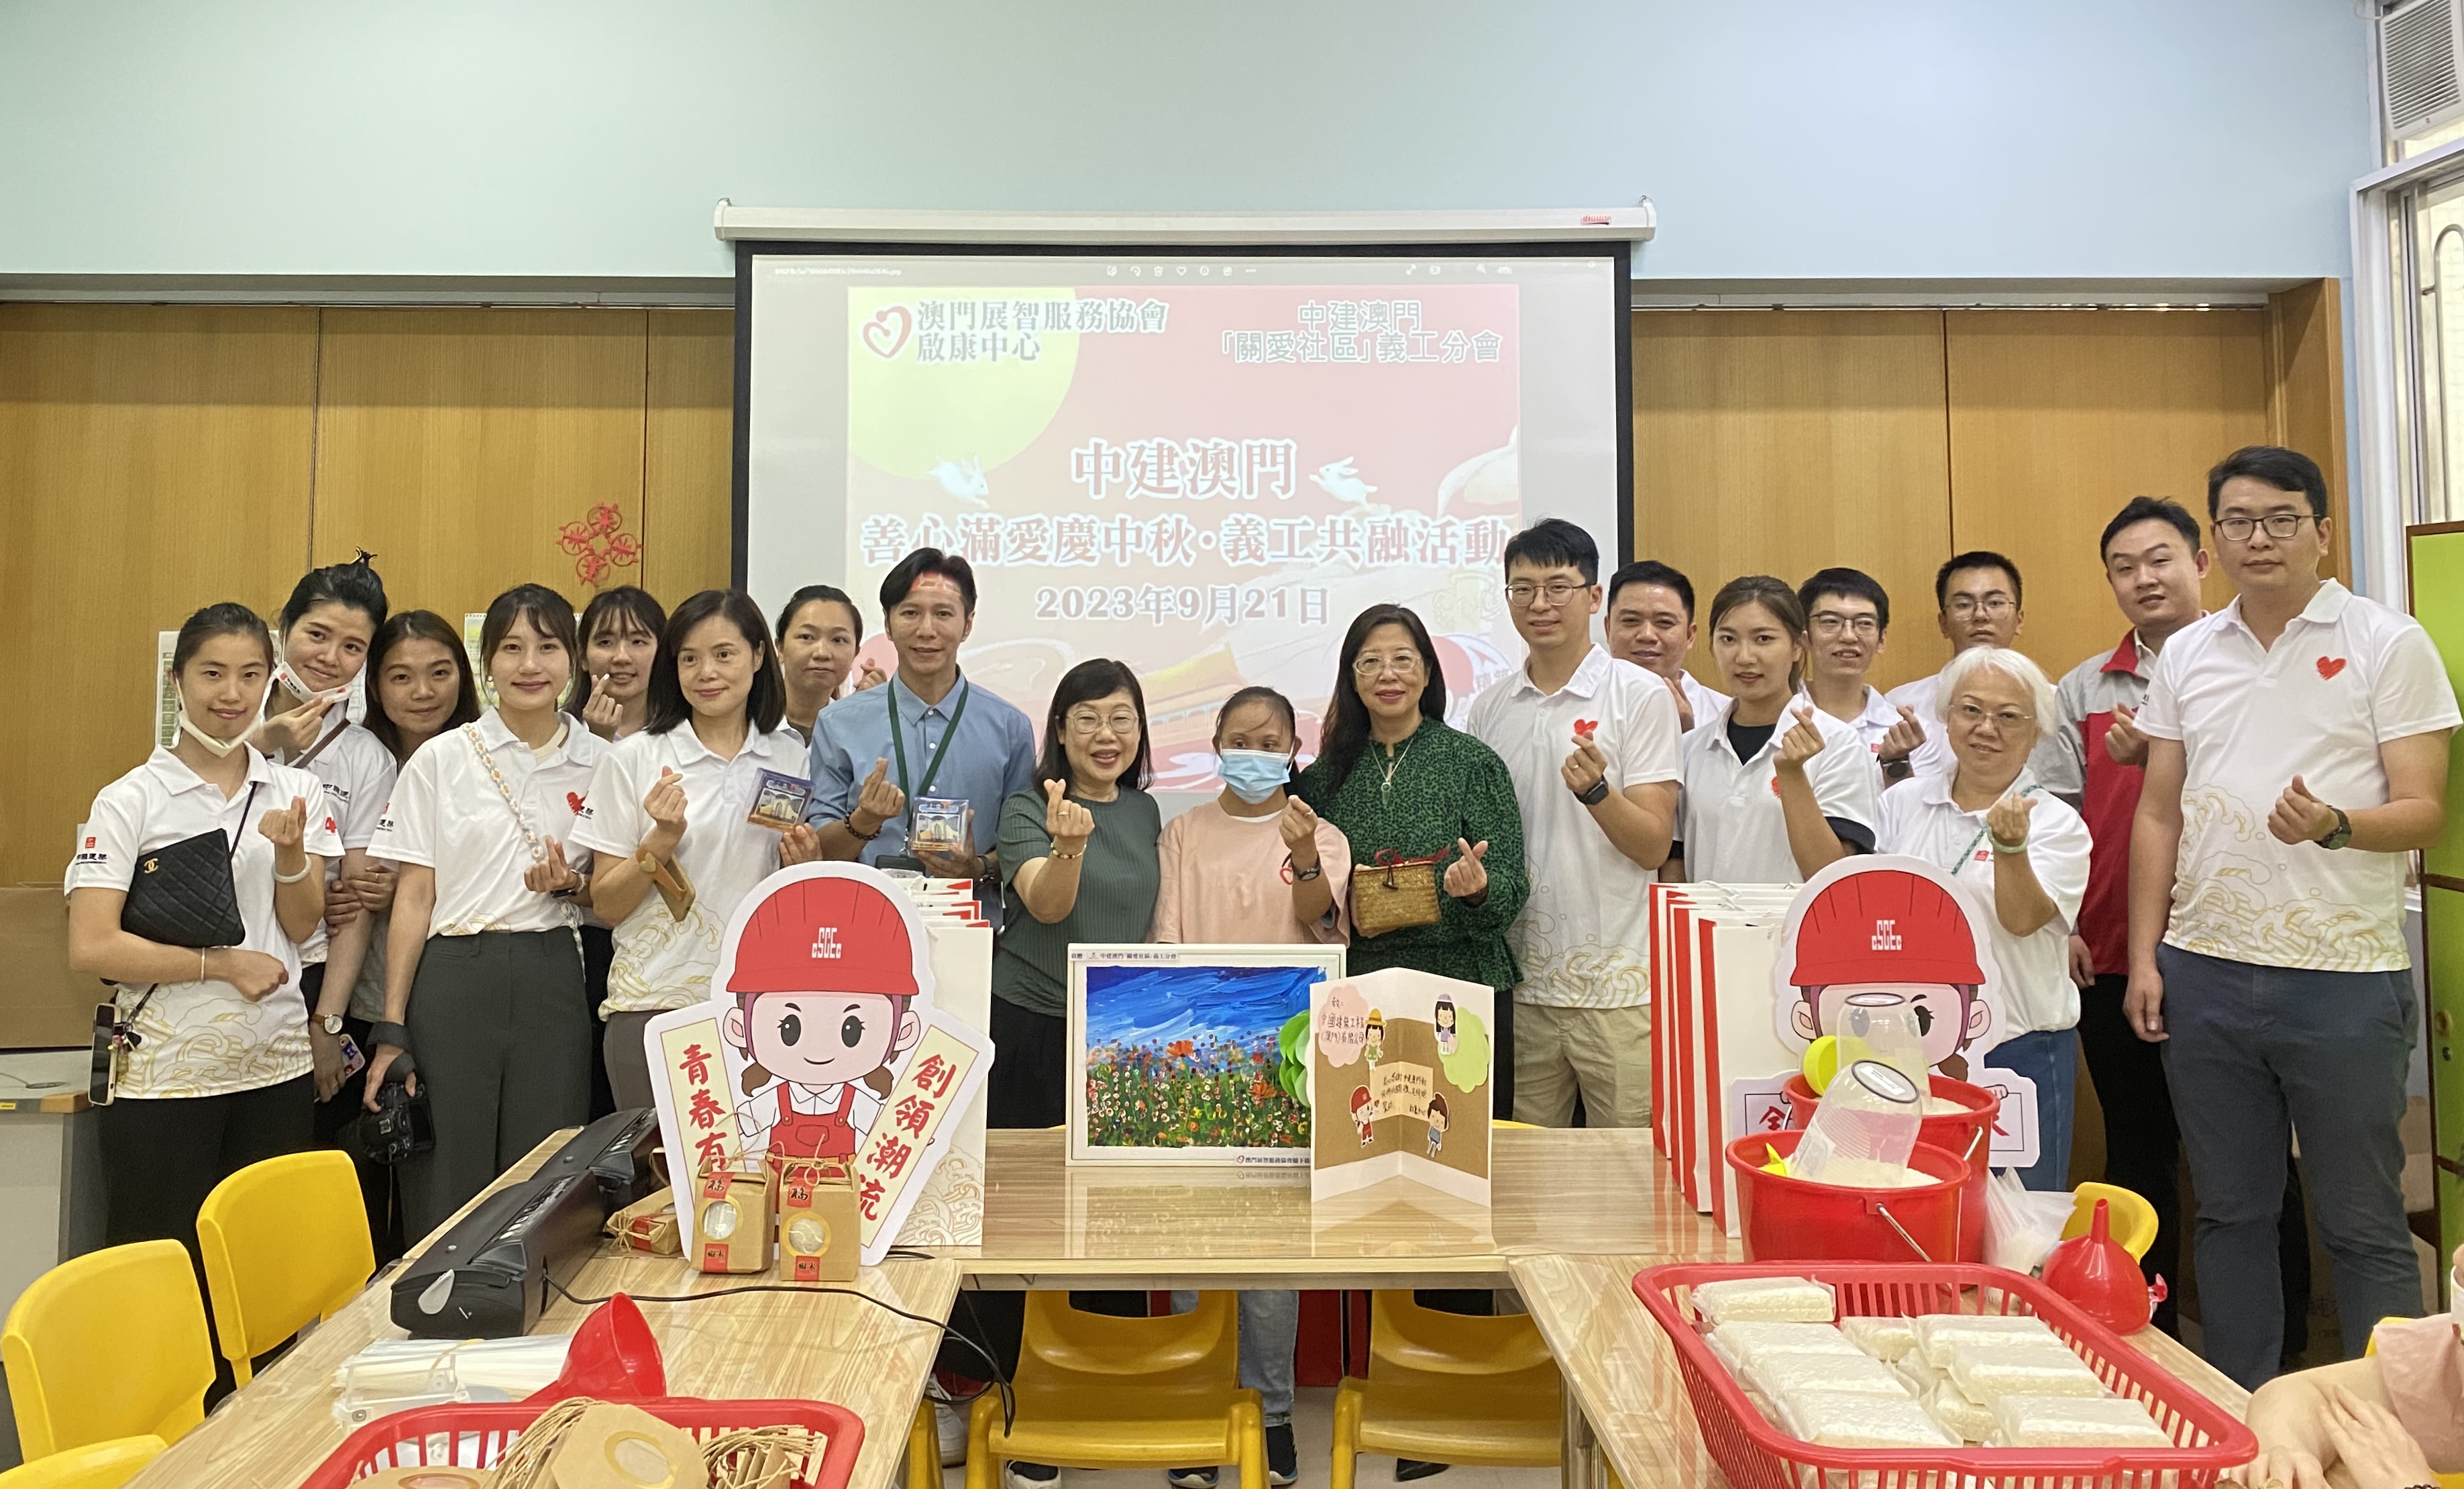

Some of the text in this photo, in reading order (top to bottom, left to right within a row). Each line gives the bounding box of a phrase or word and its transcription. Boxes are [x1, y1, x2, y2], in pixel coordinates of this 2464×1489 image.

[917, 300, 1168, 332] 澳門展智服務協會
[1299, 301, 1422, 331] 中建澳門
[916, 332, 1041, 362] 啟康中心
[1222, 331, 1502, 362] 「關愛社區」義工分會
[1073, 440, 1296, 497] 中建澳門
[1037, 585, 1329, 624] 2023年9月21日
